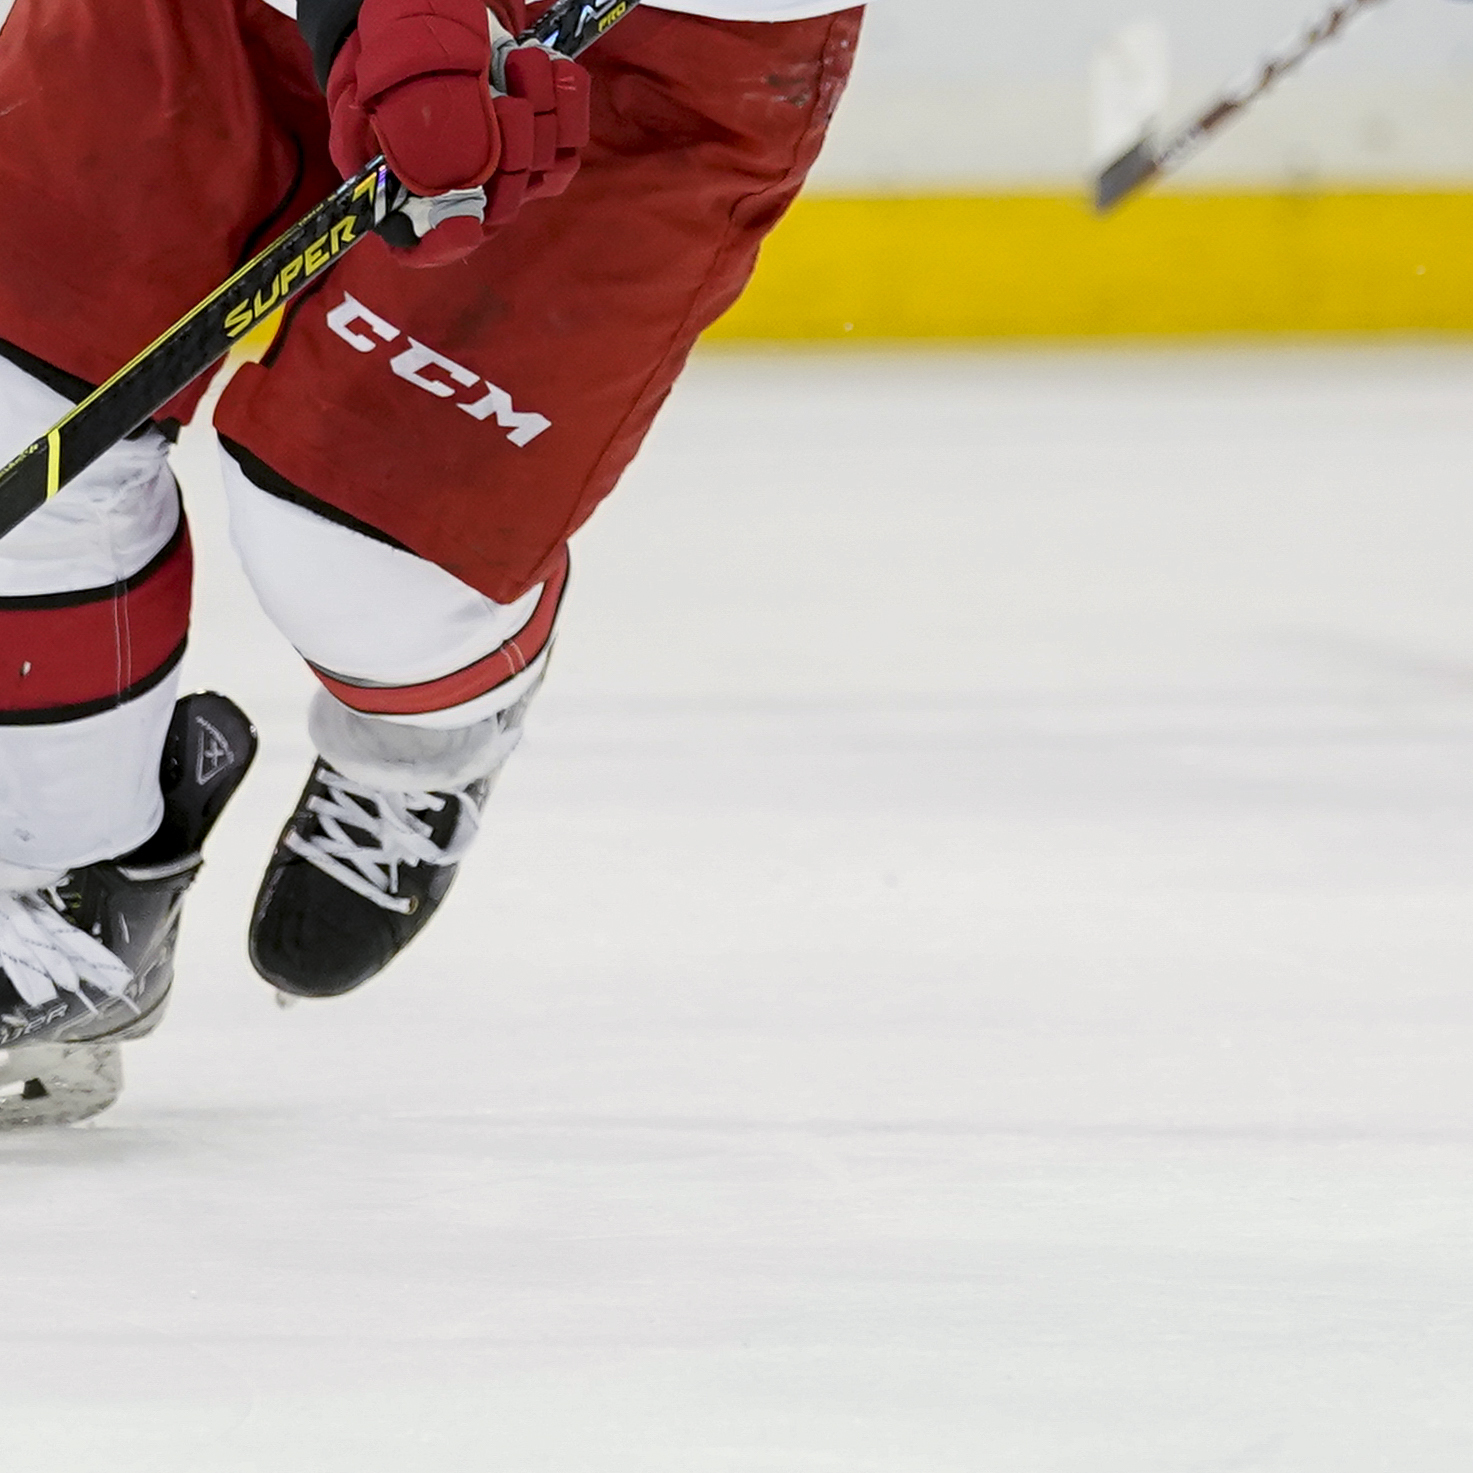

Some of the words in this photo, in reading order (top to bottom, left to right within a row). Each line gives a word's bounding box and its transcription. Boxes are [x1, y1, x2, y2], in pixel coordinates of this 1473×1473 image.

[598, 1, 627, 32] PRO
[224, 214, 357, 338] SUPER
[326, 291, 552, 448] CCM
